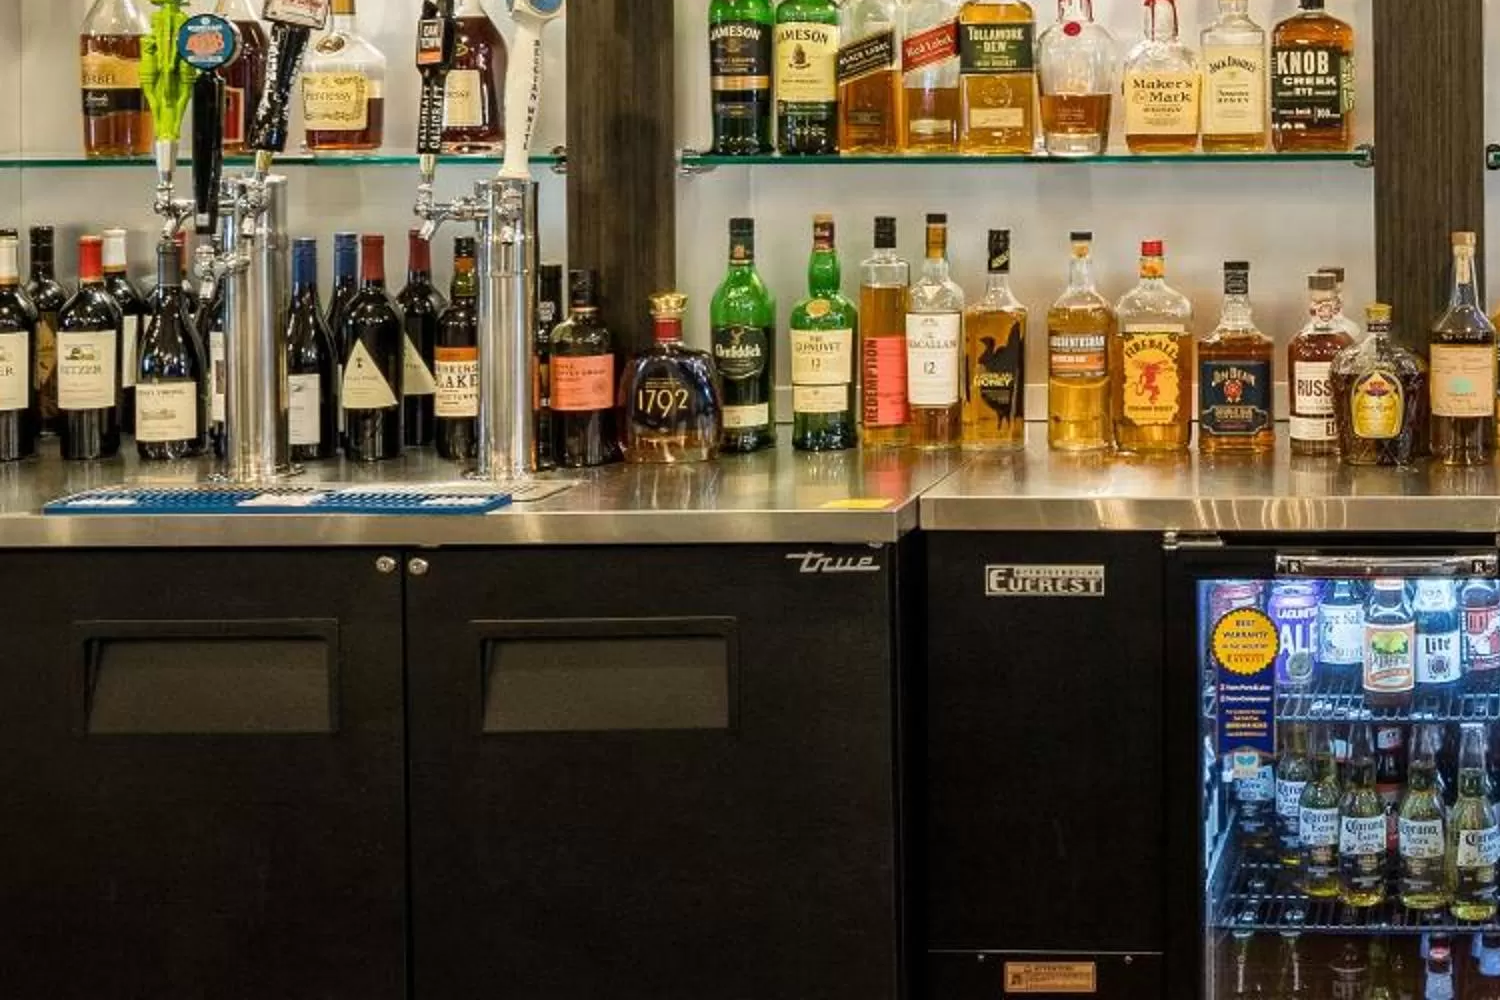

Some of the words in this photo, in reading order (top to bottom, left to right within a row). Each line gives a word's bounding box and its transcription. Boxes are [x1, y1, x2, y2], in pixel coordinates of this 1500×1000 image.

[711, 25, 761, 40] JAMESON
[968, 26, 1024, 41] TULLAMORE
[907, 46, 926, 58] Red
[926, 35, 953, 51] Label
[983, 41, 1007, 53] DEW
[1277, 50, 1329, 75] KNOB
[1132, 78, 1194, 90] Maker's
[1282, 75, 1337, 86] CREEK
[1148, 91, 1193, 103] Mark
[1295, 87, 1313, 96] RYE
[429, 85, 444, 149] CALICRAFT
[1126, 339, 1178, 360] FIREBALL
[811, 359, 821, 369] 12
[924, 362, 935, 374] 12
[865, 339, 878, 425] REDEMPTION
[637, 388, 689, 418] 1792
[989, 569, 1100, 593] EVEREST
[1223, 631, 1269, 639] WARRANTY
[1425, 636, 1452, 655] Lite
[1344, 817, 1385, 832] Corona
[1401, 822, 1439, 837] Corona
